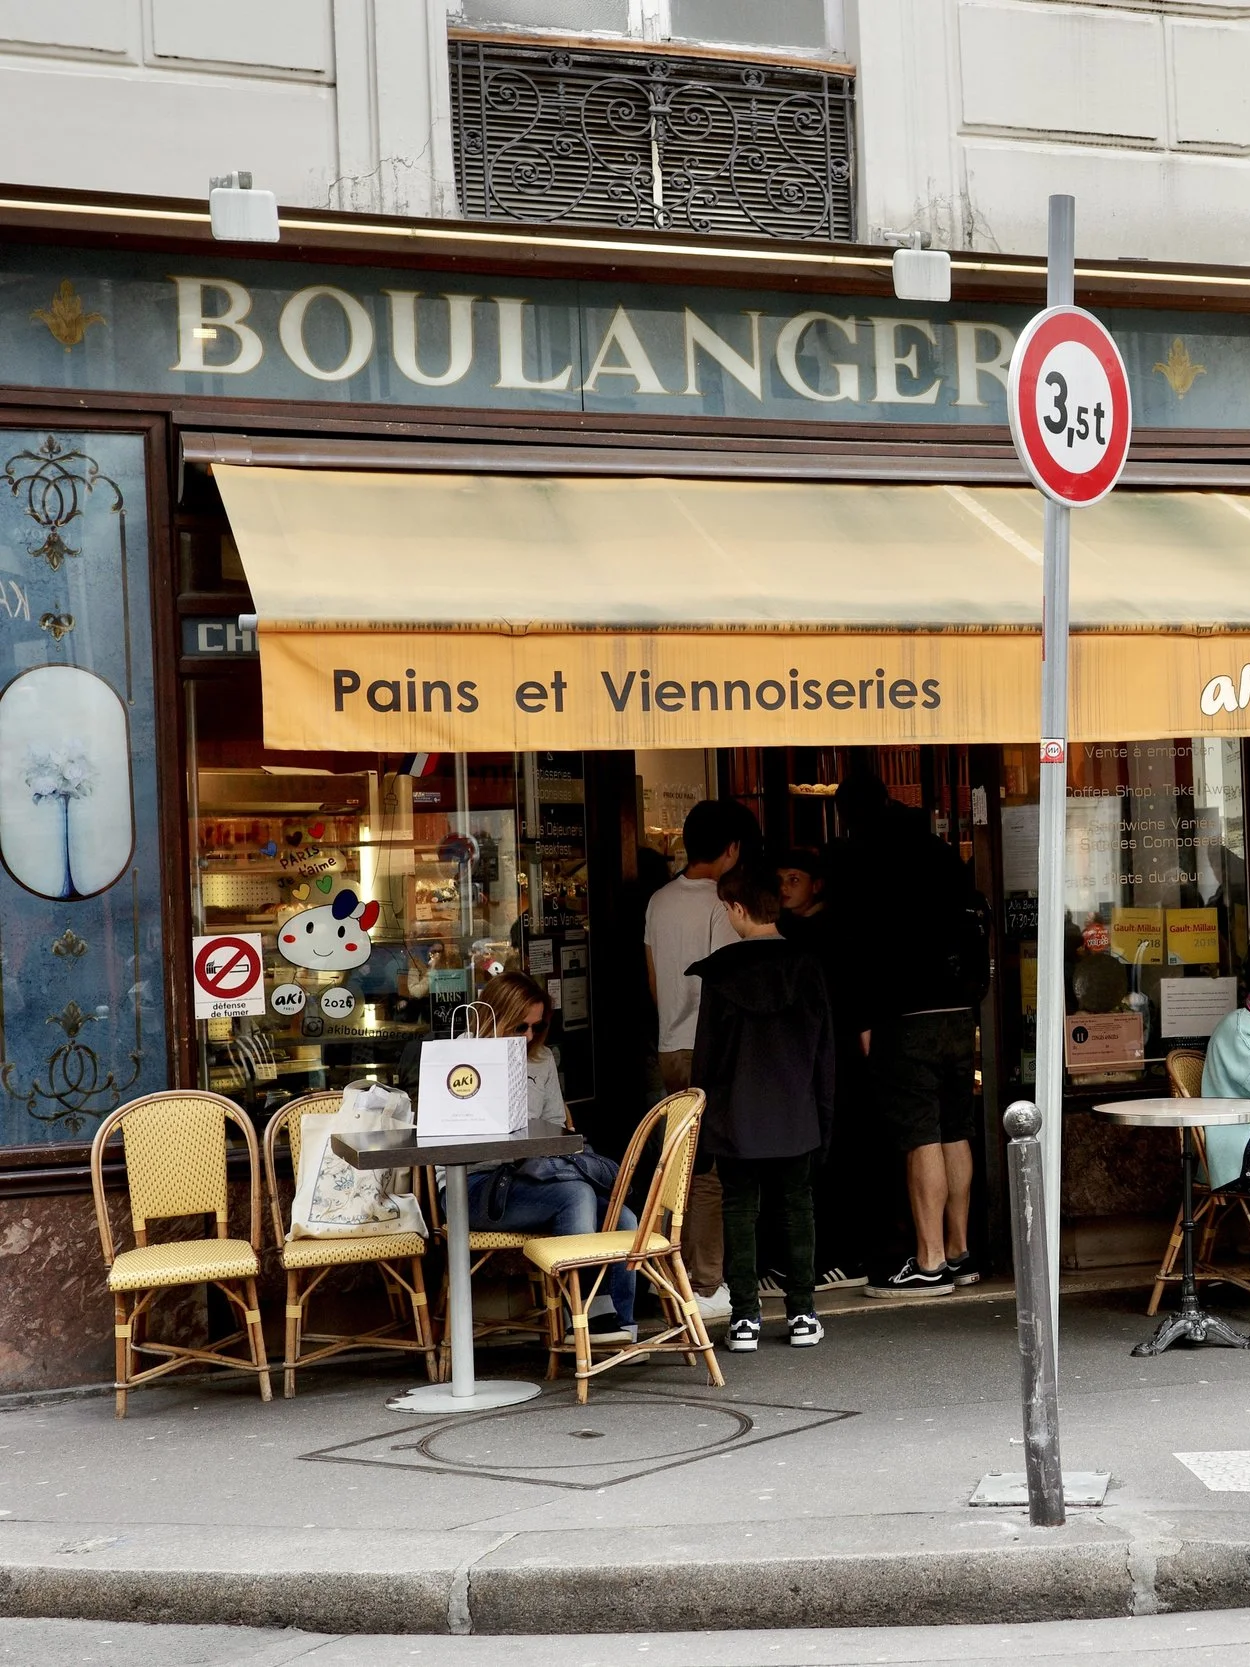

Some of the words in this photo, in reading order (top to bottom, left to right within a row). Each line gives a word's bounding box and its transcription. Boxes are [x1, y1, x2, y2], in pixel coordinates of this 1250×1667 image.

[168, 275, 1012, 407] BOULANGER
[197, 623, 259, 652] CH
[333, 669, 479, 713] Pains
[515, 671, 567, 713] et
[601, 668, 941, 712] Viennoiseries
[1085, 746, 1127, 759] Vente
[1134, 745, 1141, 756] à
[1148, 746, 1215, 758] emporter
[1066, 786, 1109, 798] Coffee
[1163, 784, 1194, 796] Take
[535, 840, 572, 855] Breakfast
[280, 845, 320, 869] PARIS
[277, 877, 295, 888] Je
[1149, 871, 1166, 883] du
[1171, 871, 1205, 883] Jour
[435, 992, 461, 1003] PARIS
[210, 1010, 221, 1018] de
[224, 1009, 249, 1017] fumer
[213, 1002, 246, 1011] défense
